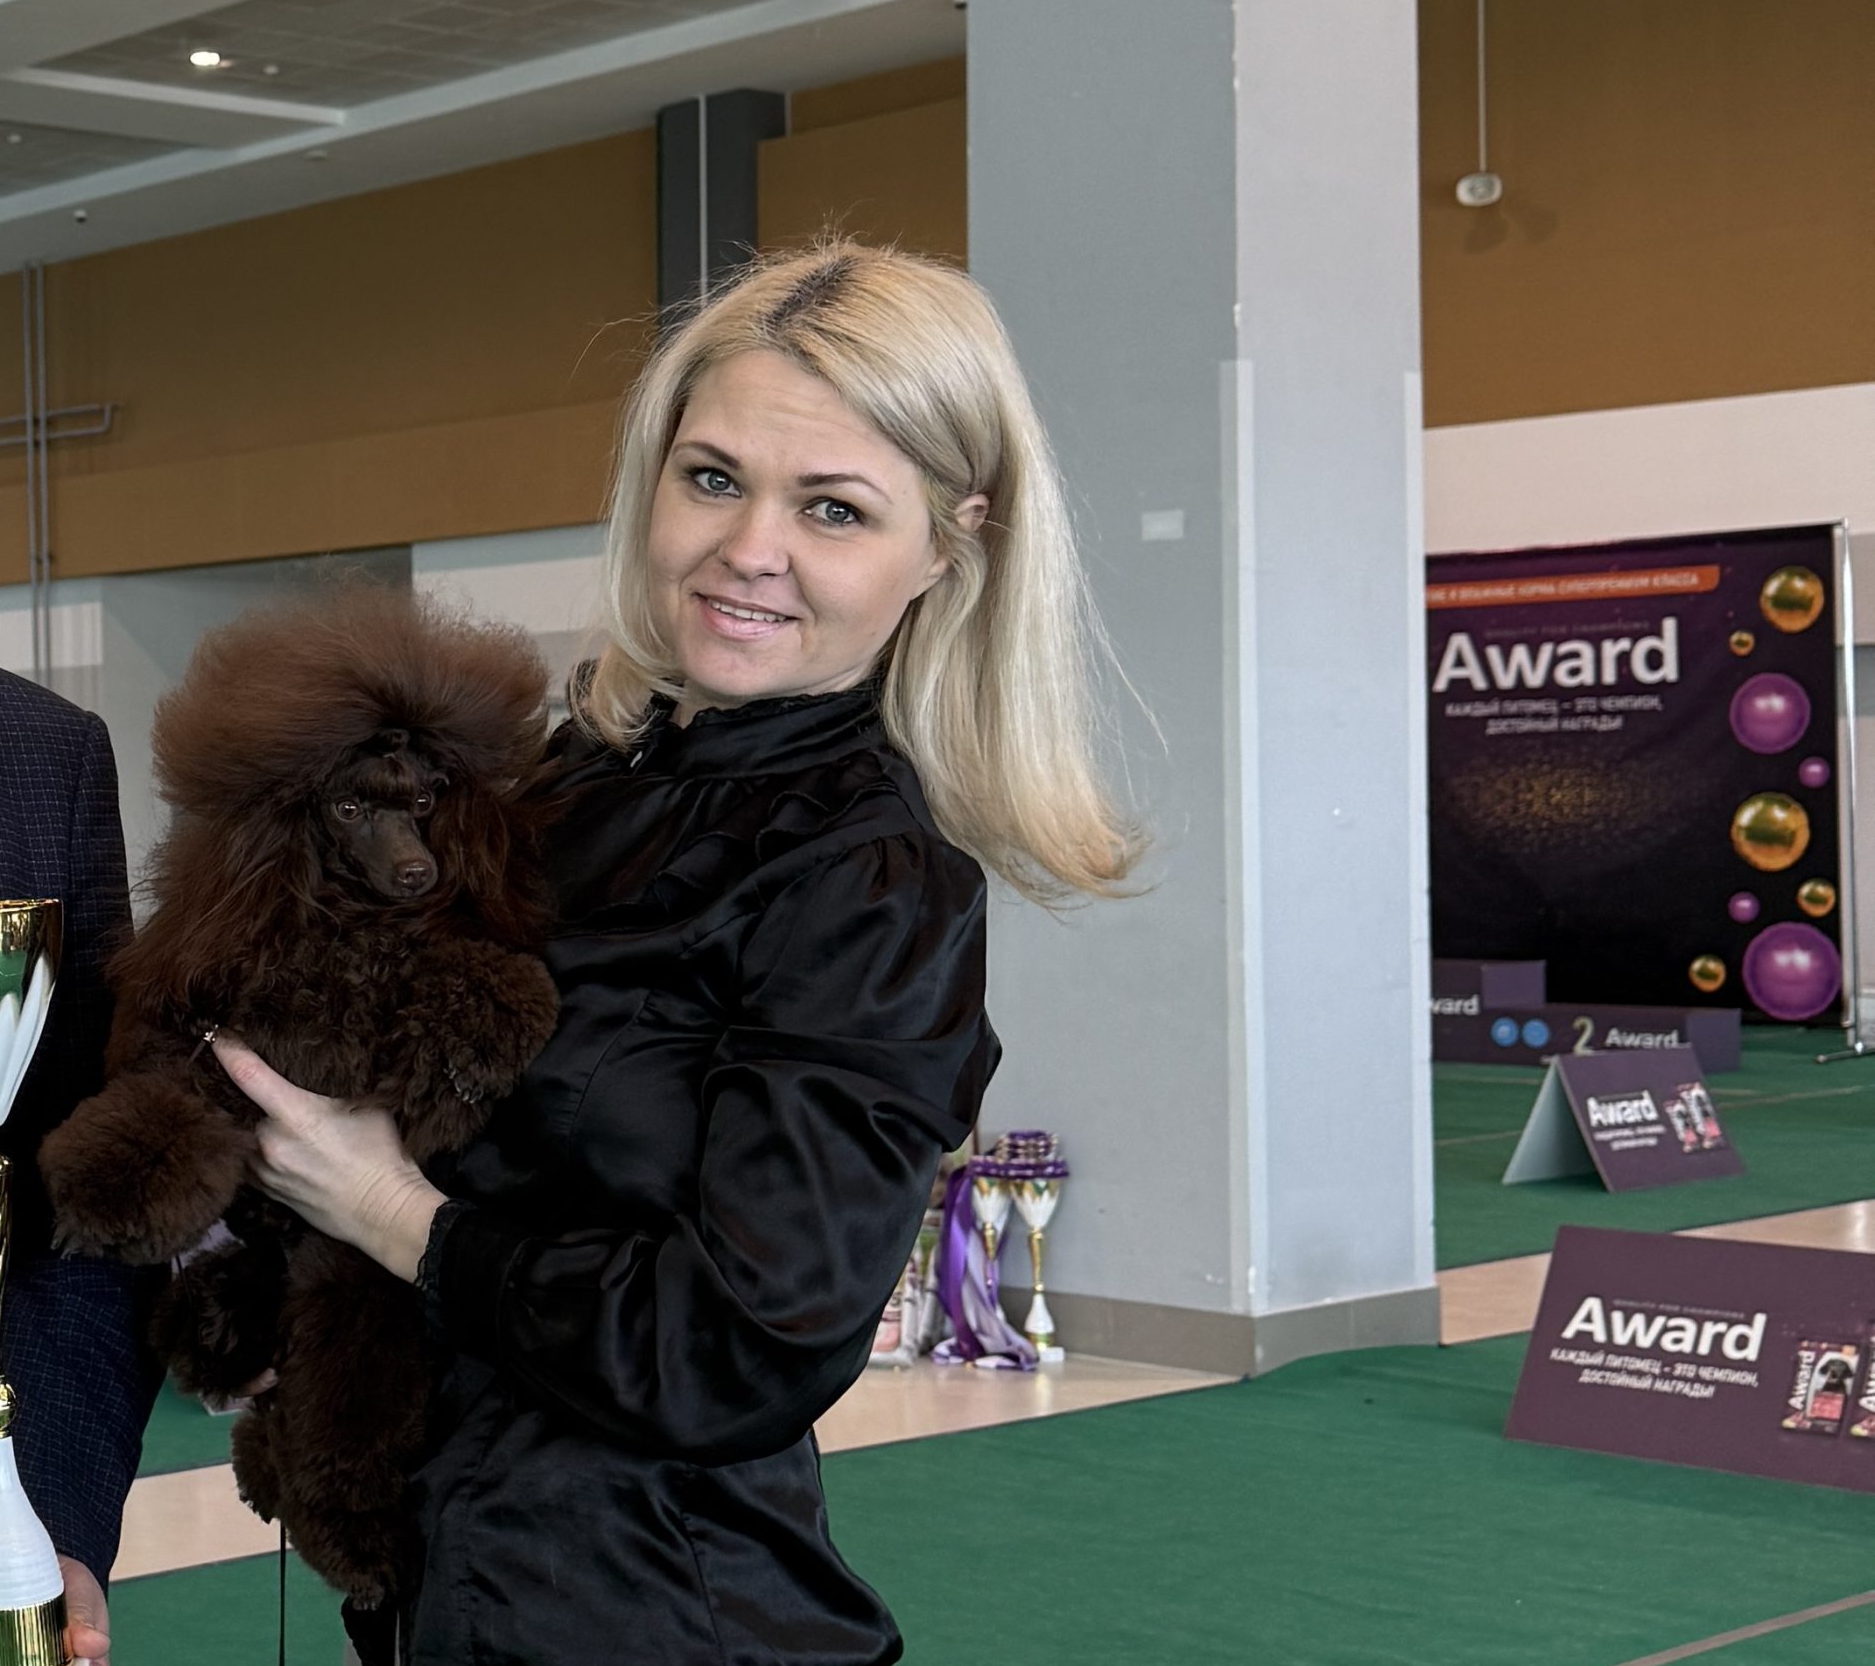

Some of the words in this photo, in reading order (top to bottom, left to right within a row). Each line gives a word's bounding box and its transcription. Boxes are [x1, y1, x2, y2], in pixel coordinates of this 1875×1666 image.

[1432, 616, 1679, 693] Award
[1431, 994, 1480, 1015] ward
[1573, 1016, 1595, 1053] 2
[1605, 1027, 1678, 1049] Award
[1587, 1090, 1659, 1128] Award
[1561, 1296, 1768, 1362] Award
[1549, 1347, 1605, 1366] КАЖДЫЙ
[1605, 1353, 1663, 1375] ПИТОМЕЦ
[1672, 1362, 1698, 1378] ЭТО
[1578, 1368, 1653, 1390] ДОСТОЙНЫЙ
